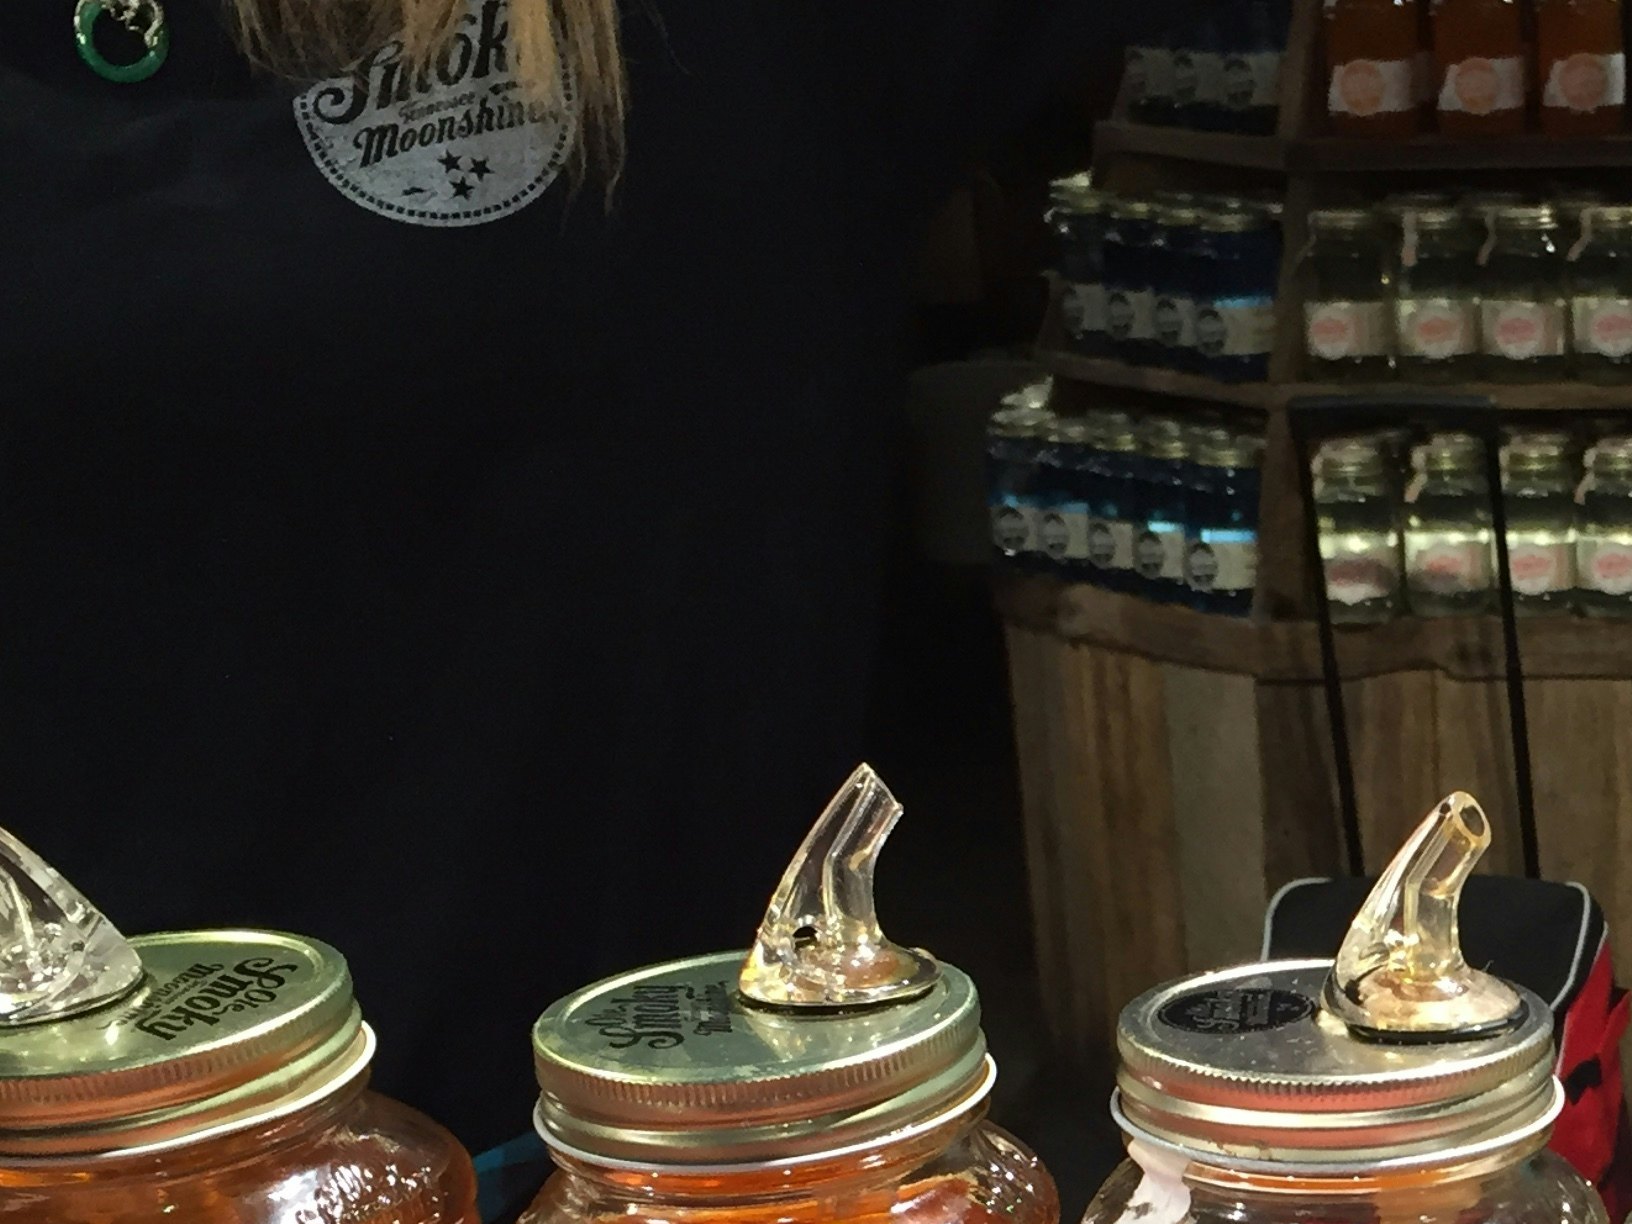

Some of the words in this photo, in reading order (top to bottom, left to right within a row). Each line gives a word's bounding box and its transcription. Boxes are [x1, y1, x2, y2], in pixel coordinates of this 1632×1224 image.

[131, 957, 298, 1042] Smoky
[216, 987, 278, 1022] Ole
[600, 984, 695, 1050] Smoky
